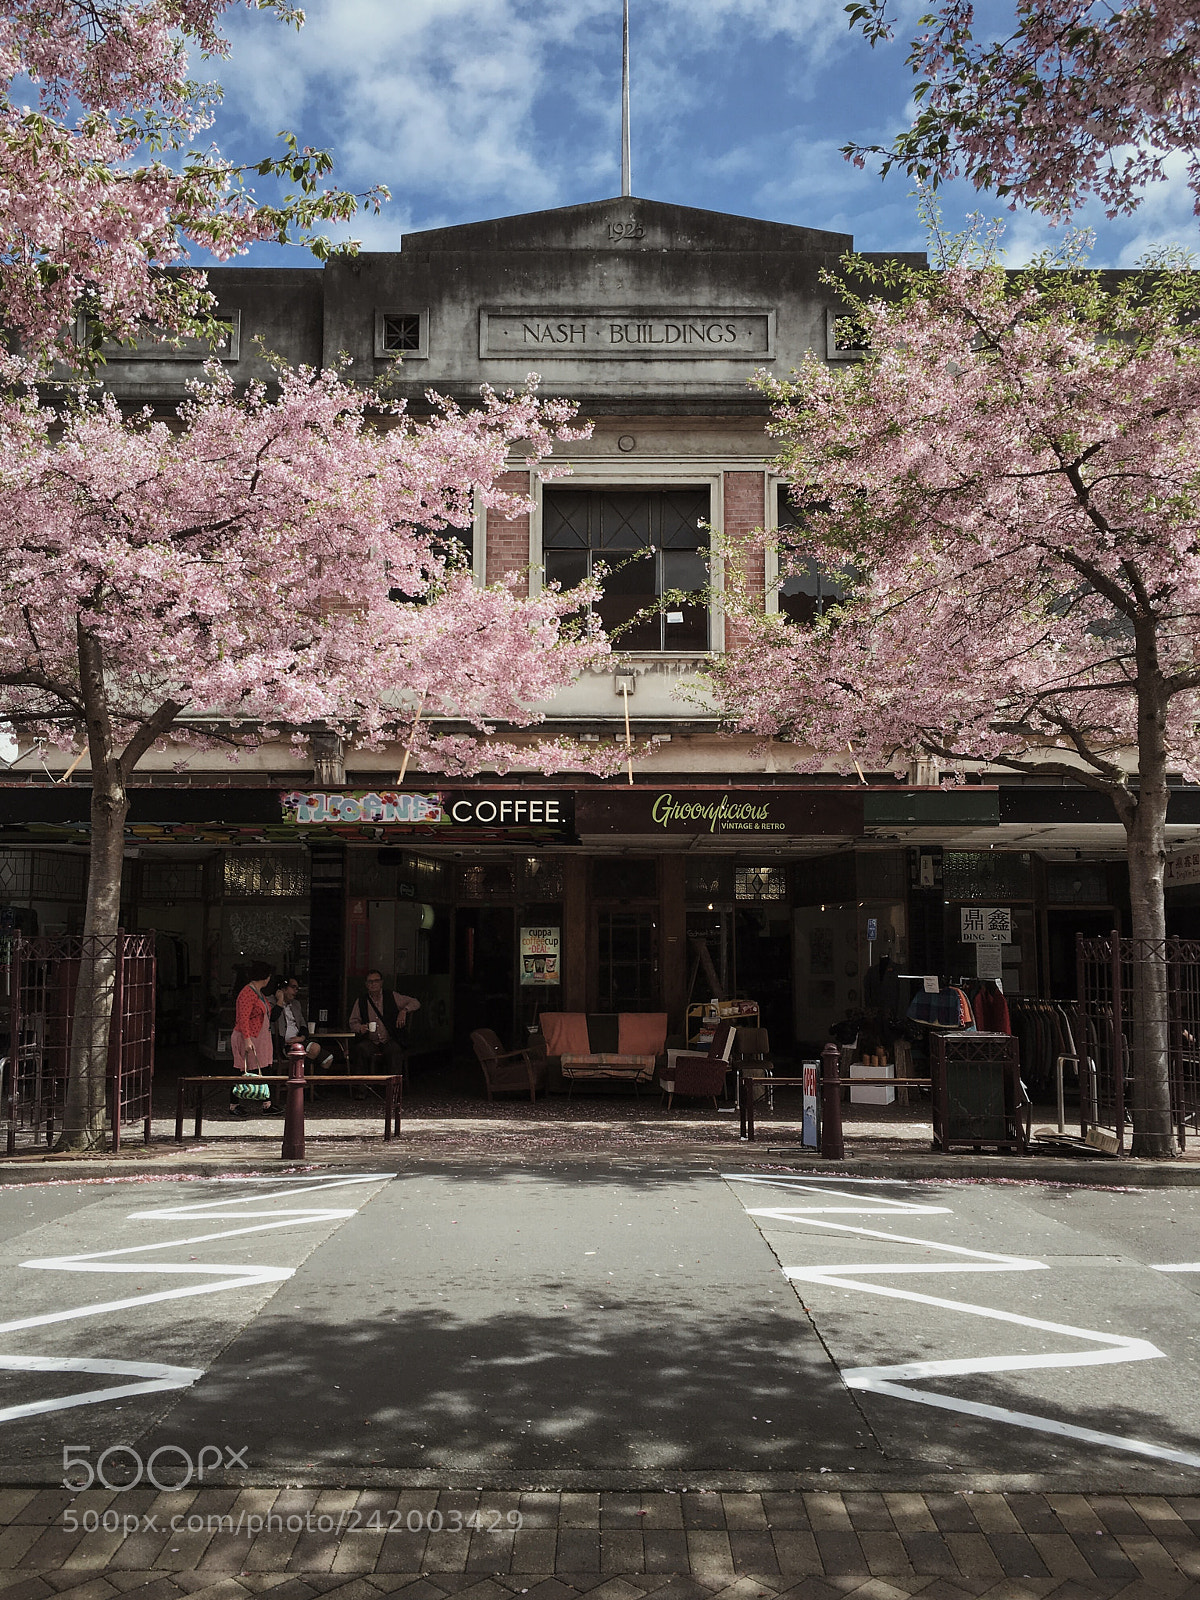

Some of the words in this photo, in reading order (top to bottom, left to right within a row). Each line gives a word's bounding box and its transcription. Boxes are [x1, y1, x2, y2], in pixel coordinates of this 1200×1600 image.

[523, 323, 587, 344] NASH
[610, 323, 736, 344] BUILDINGS
[652, 793, 770, 833] Groovylicious
[721, 822, 753, 831] VINTAGE
[754, 822, 760, 830] &
[761, 822, 786, 831] RETRO
[529, 929, 552, 938] cuppa
